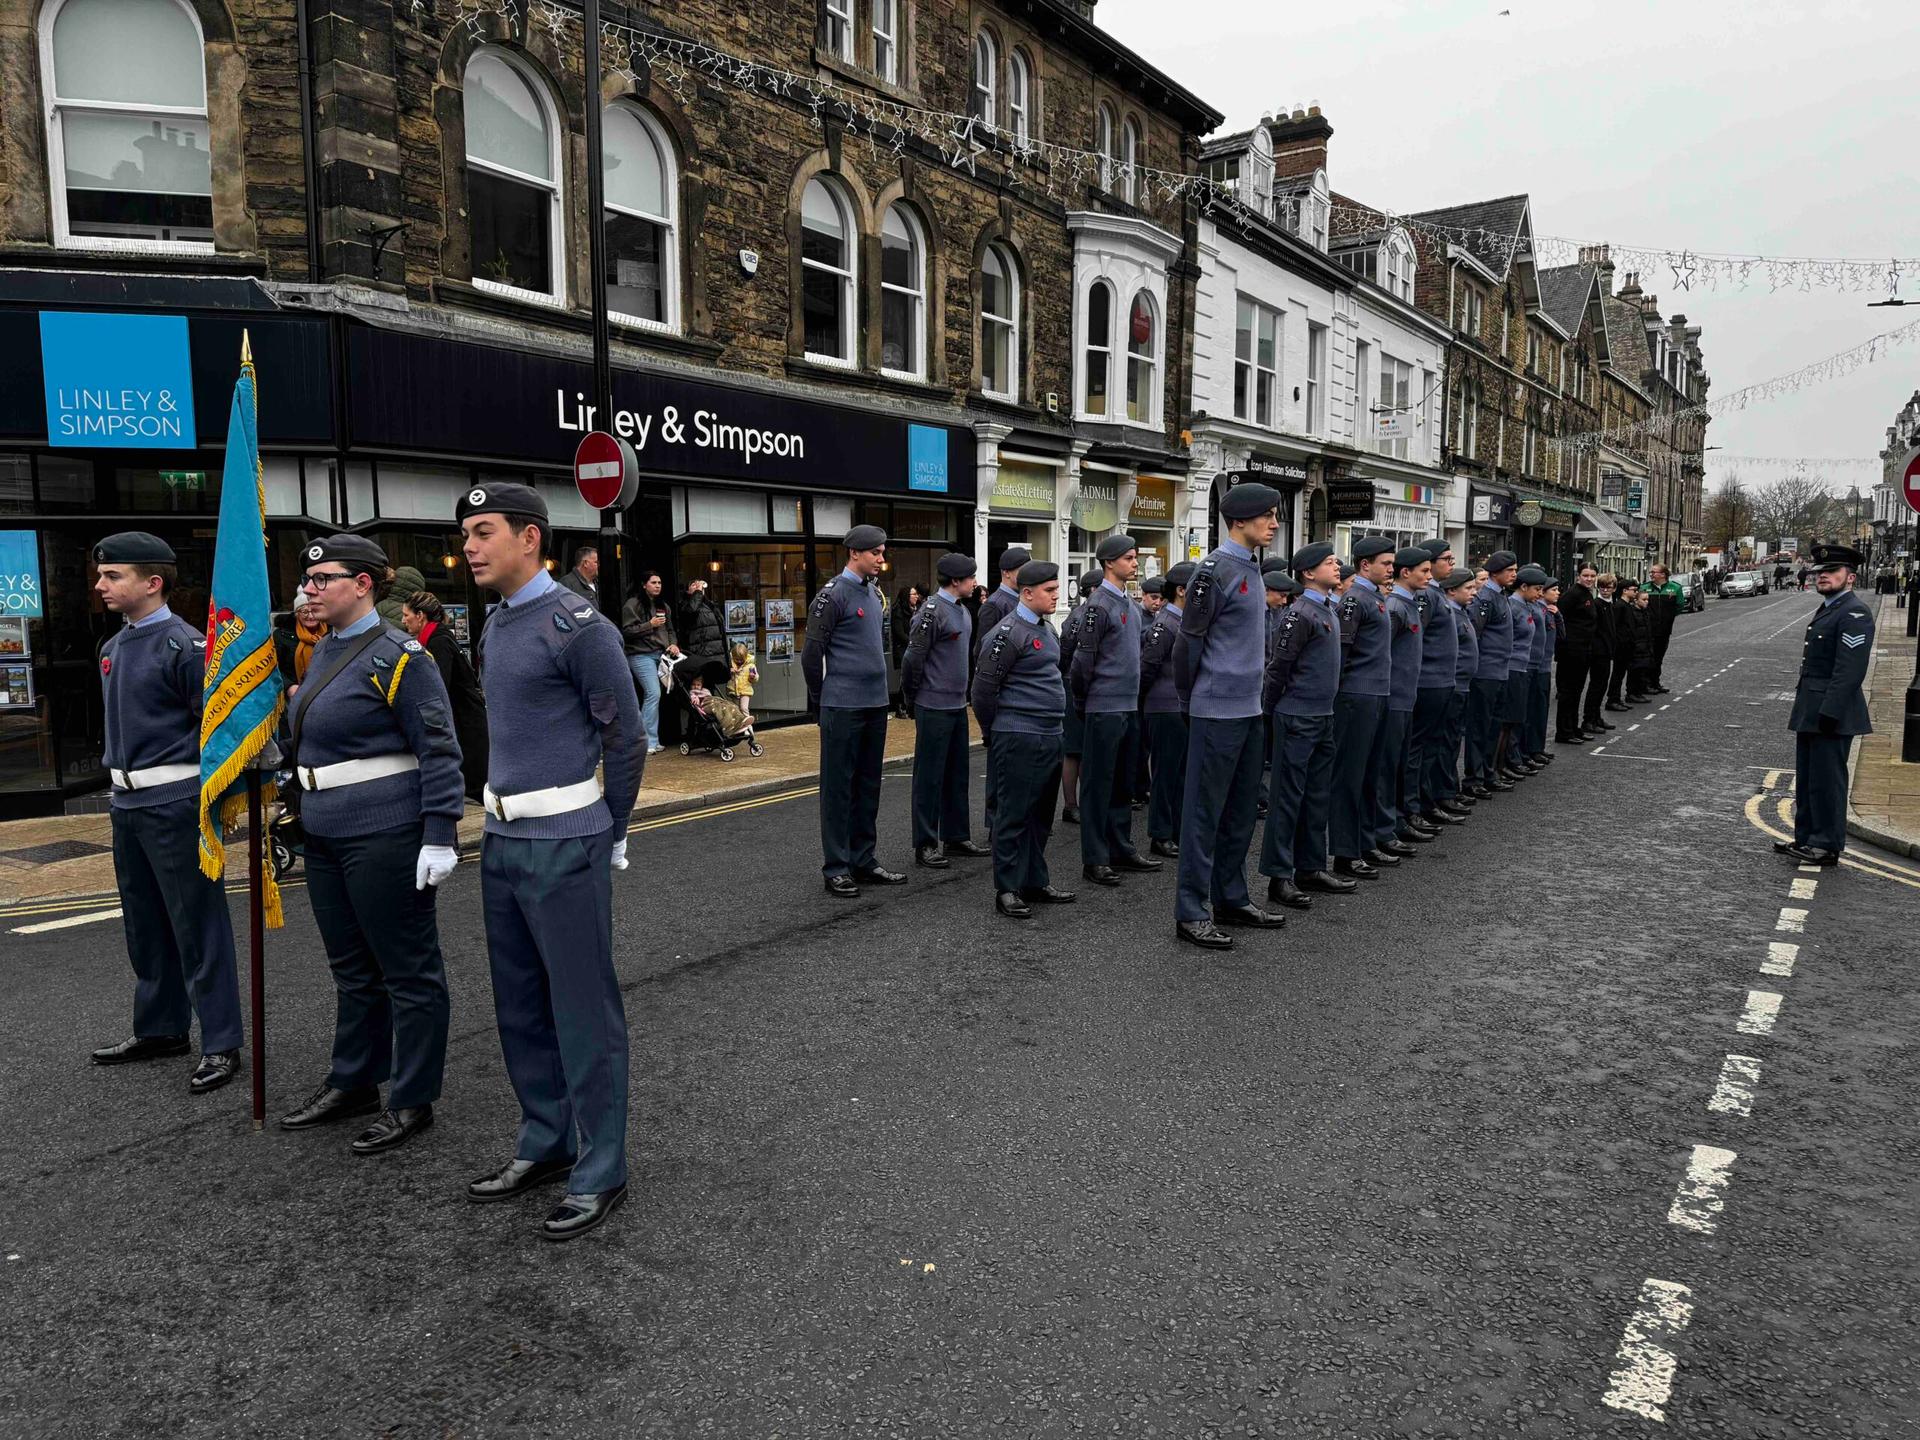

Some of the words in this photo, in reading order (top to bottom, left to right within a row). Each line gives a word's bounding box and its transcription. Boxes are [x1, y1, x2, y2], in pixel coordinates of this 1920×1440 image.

[58, 388, 152, 411] LINLEY
[158, 389, 178, 412] &
[60, 414, 181, 437] SIMPSON
[557, 389, 652, 450] Liney
[661, 405, 686, 444] &
[694, 410, 804, 464] Simpson
[914, 461, 938, 474] LINLEY
[1285, 466, 1306, 479] Solicitors
[914, 474, 945, 487] SIMPSON
[1075, 485, 1116, 501] EADNALL
[1135, 495, 1167, 511] Definitive
[20, 573, 36, 591] &
[205, 622, 244, 686] ADVENTURE
